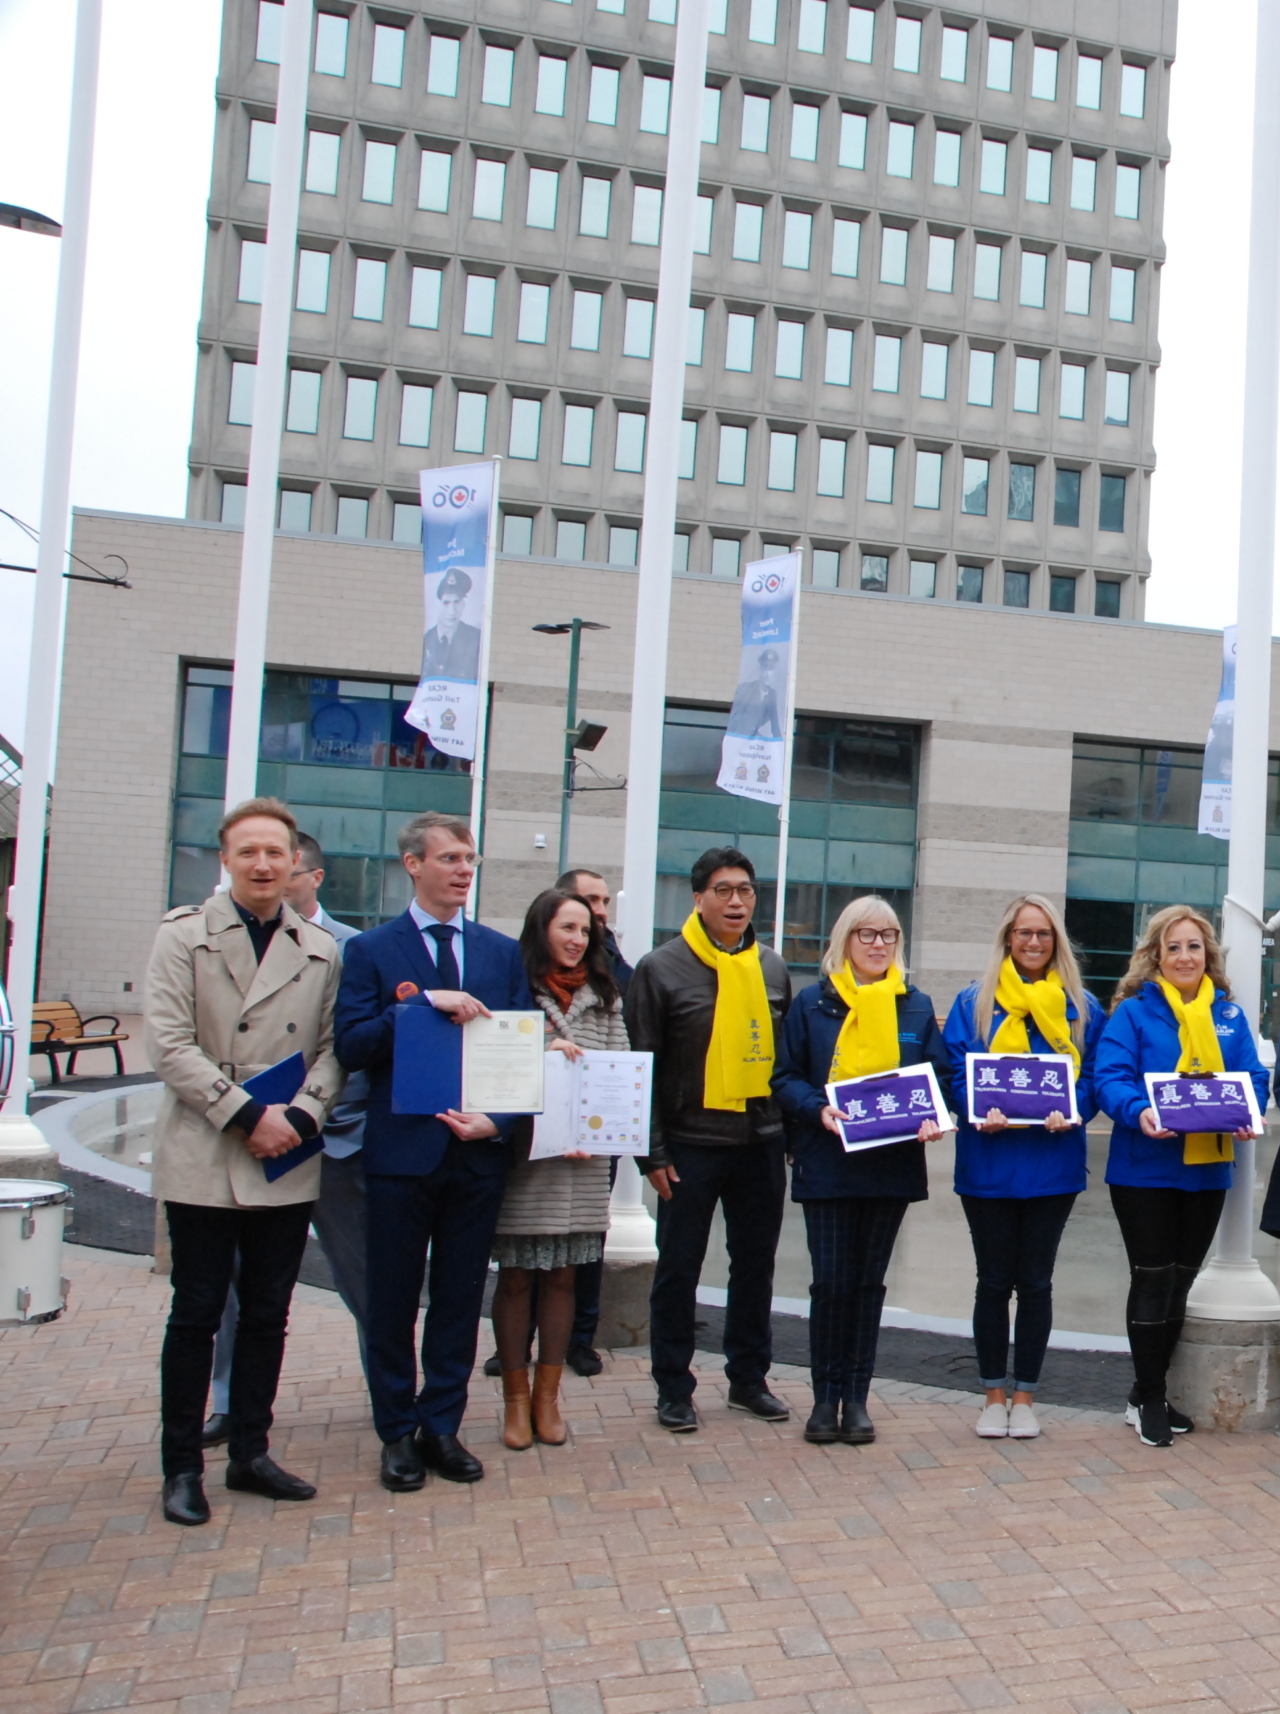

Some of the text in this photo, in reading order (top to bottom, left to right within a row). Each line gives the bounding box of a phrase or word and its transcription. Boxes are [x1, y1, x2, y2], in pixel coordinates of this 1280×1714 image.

[978, 1066, 1064, 1090] 真善忍
[844, 1088, 932, 1121] 真善忍
[1159, 1083, 1243, 1105] 真善忍
